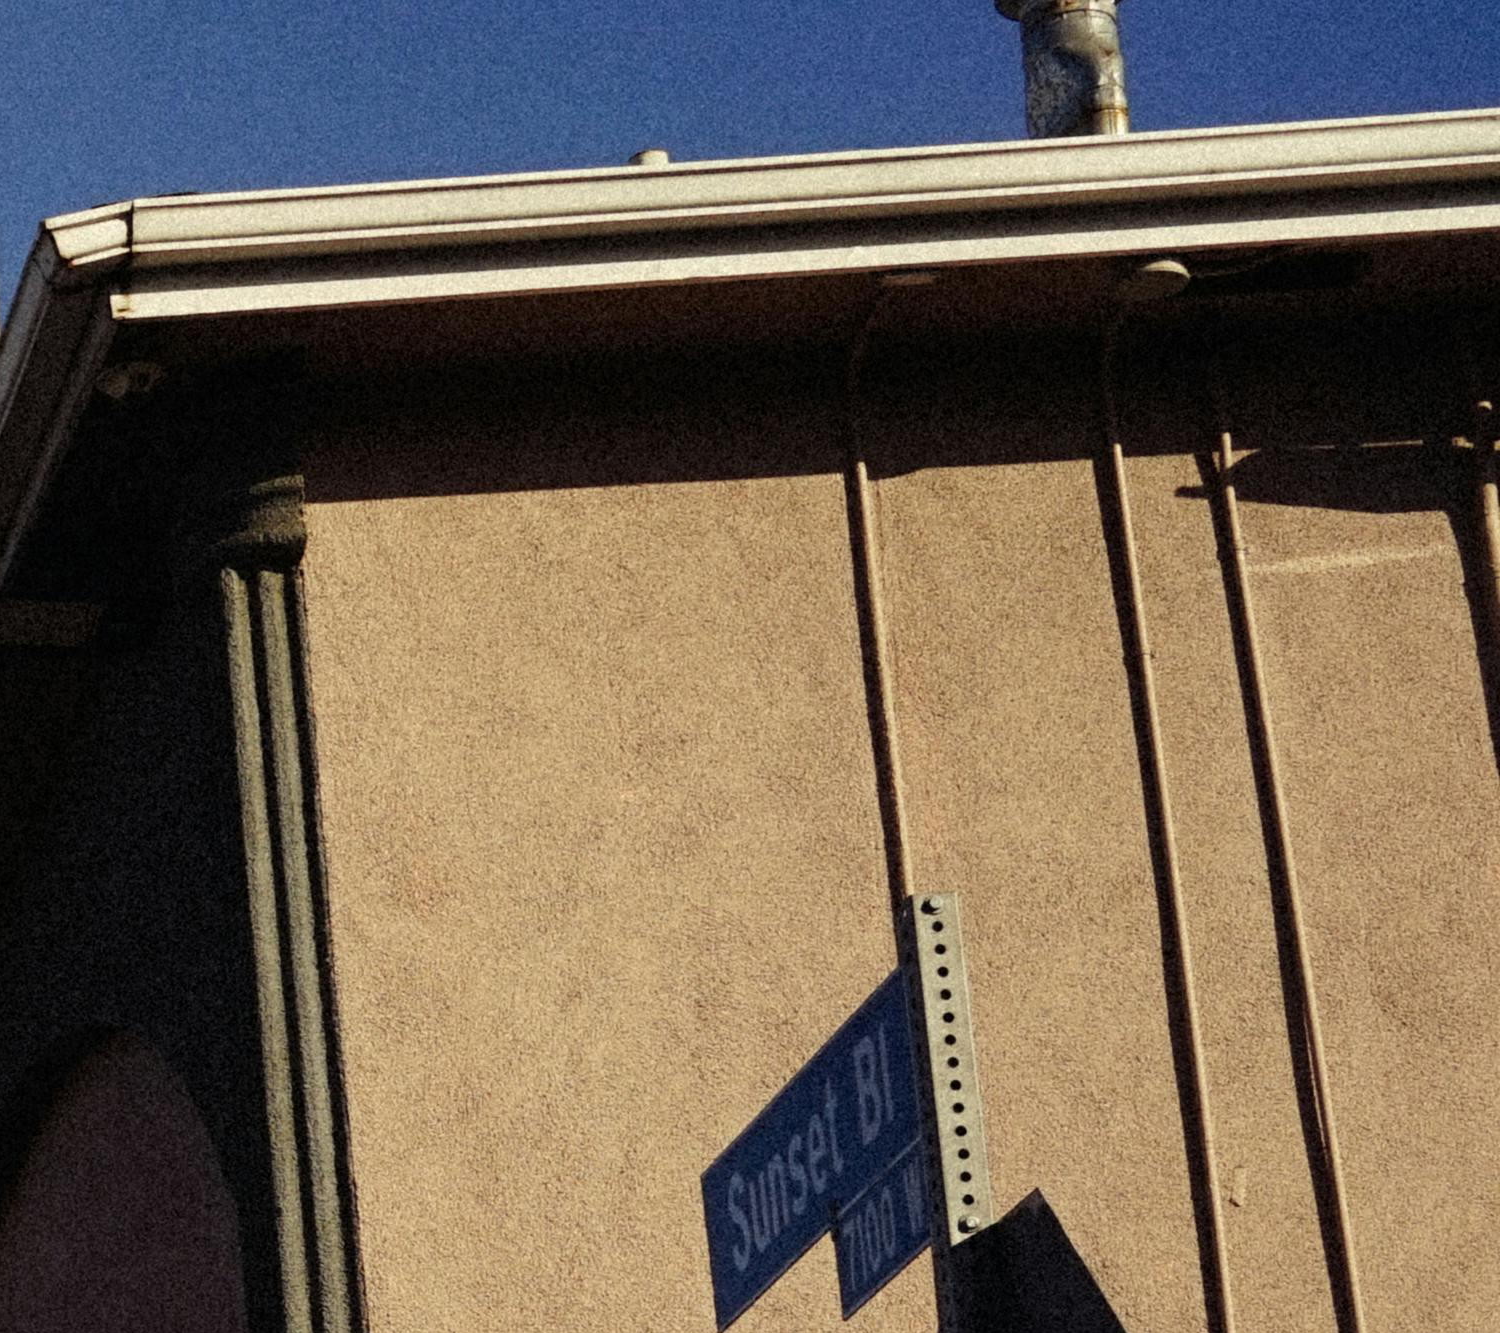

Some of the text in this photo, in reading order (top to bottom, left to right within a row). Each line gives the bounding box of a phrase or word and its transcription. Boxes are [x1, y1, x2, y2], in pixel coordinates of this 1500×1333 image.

[727, 1022, 895, 1273] Sunset Bl
[842, 1184, 897, 1291] 7100
